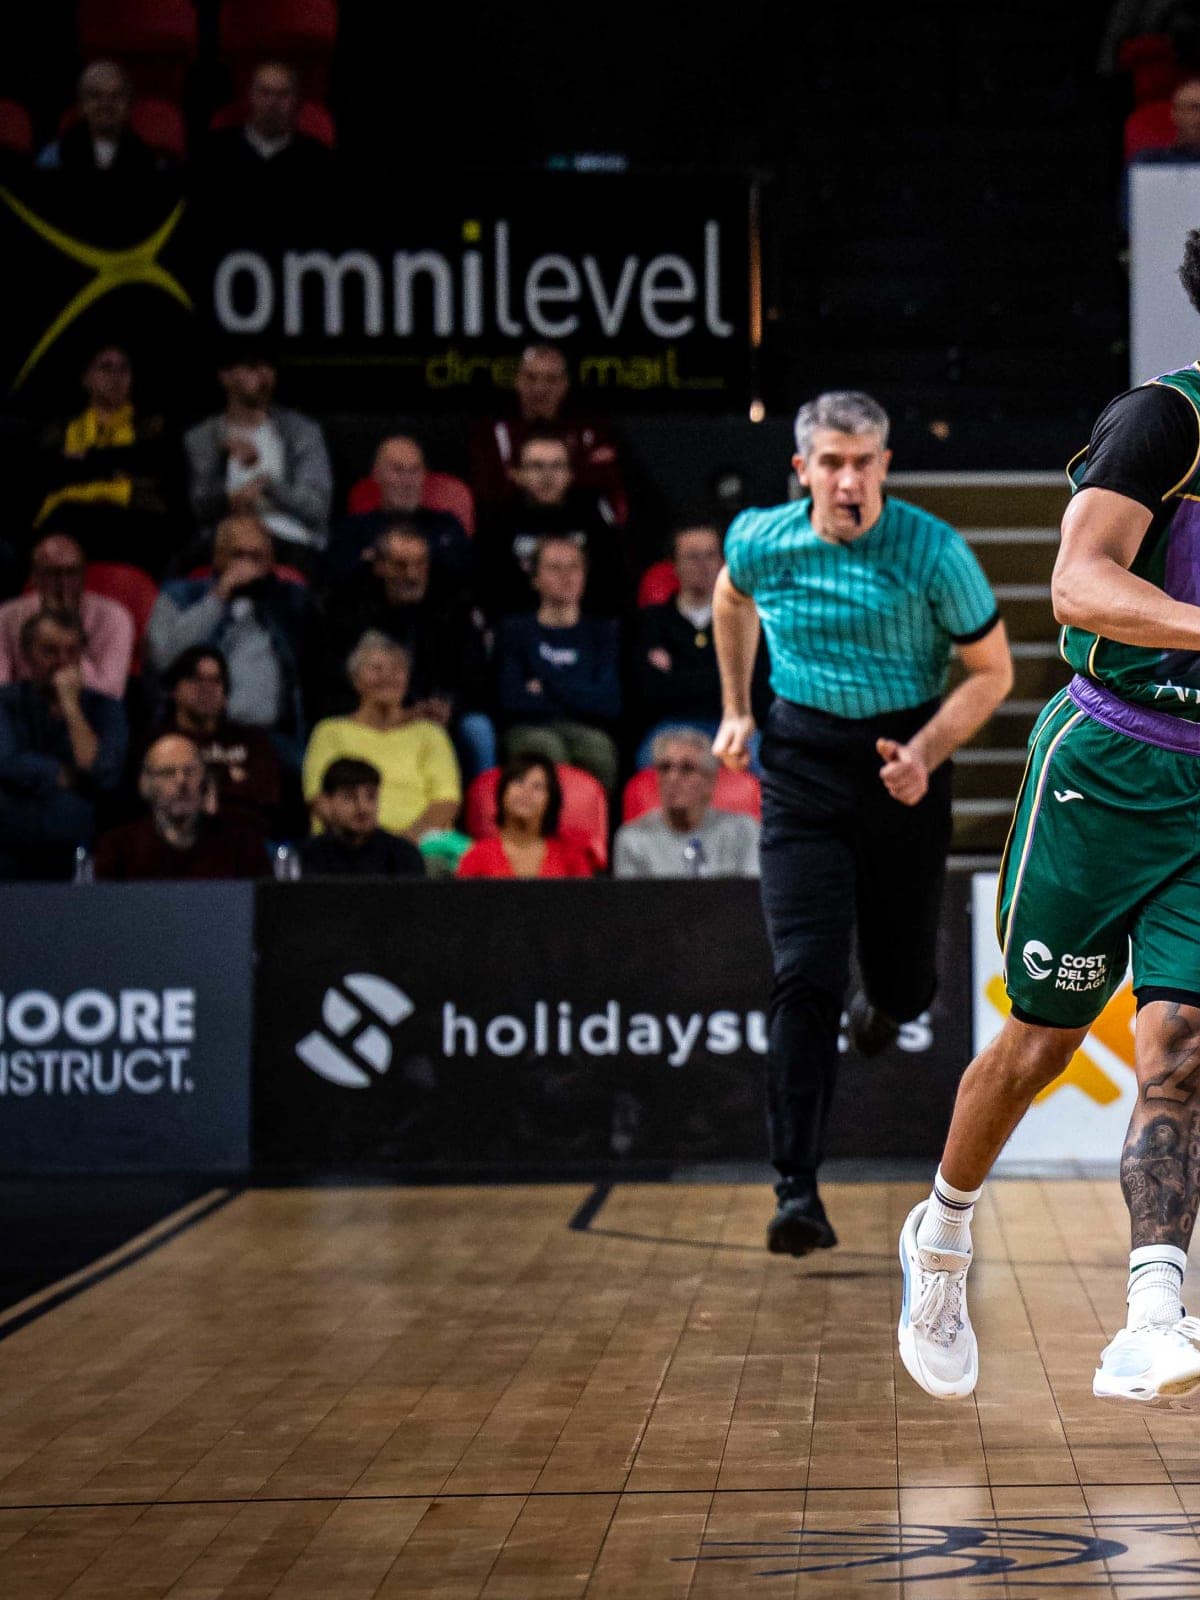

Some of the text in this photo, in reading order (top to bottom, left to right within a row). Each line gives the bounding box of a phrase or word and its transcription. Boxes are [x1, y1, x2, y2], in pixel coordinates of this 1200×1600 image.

[214, 220, 732, 339] omnilevel
[424, 345, 518, 388] dire
[1057, 966, 1085, 981] DEL
[1061, 953, 1106, 969] COST
[0, 987, 196, 1044] OORE
[443, 1000, 933, 1066] holidaysus
